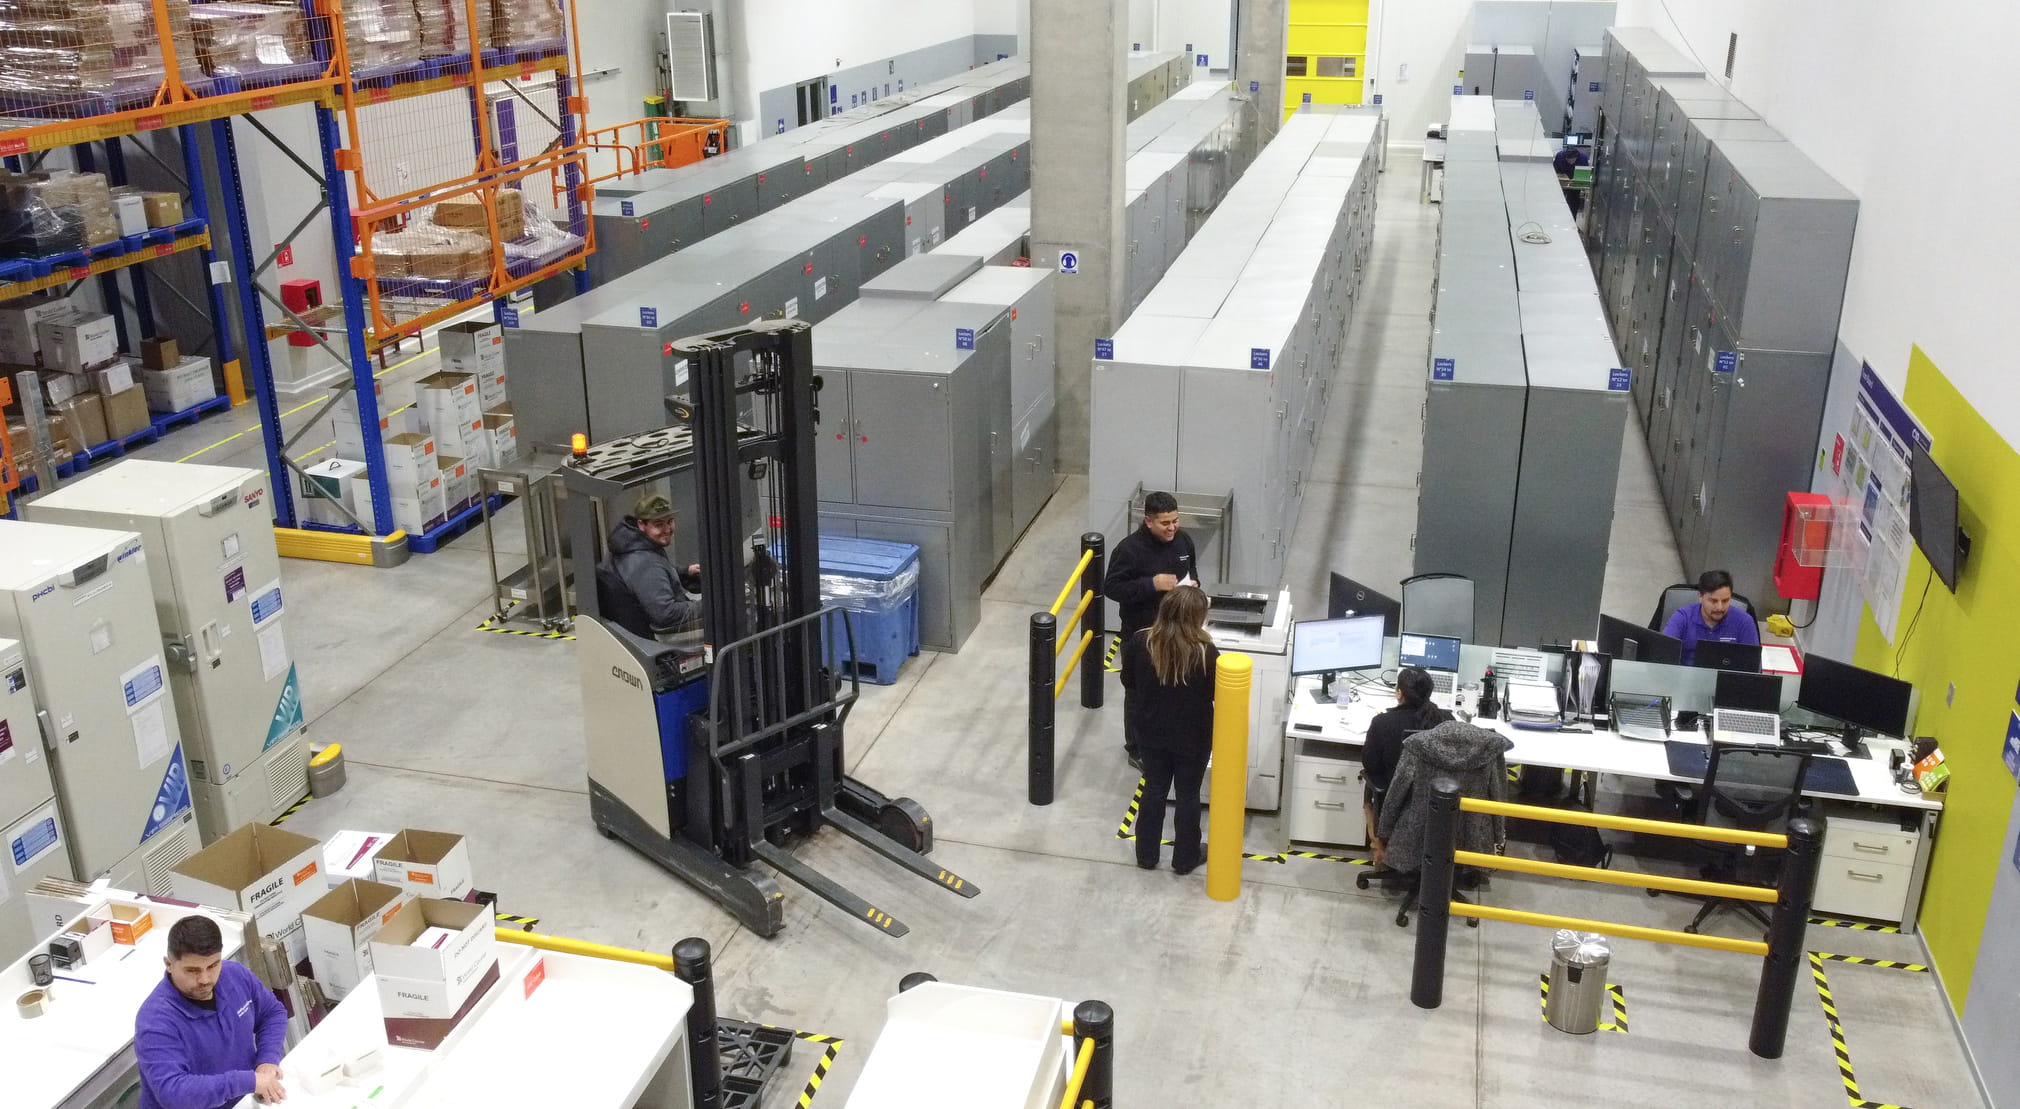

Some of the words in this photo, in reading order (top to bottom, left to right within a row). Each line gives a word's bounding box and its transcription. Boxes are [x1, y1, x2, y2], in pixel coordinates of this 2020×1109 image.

[243, 488, 263, 504] SANYO
[375, 859, 403, 868] FRAGILE
[250, 877, 284, 903] FRAGILE
[275, 921, 294, 938] World
[397, 991, 429, 1001] FRAGILE
